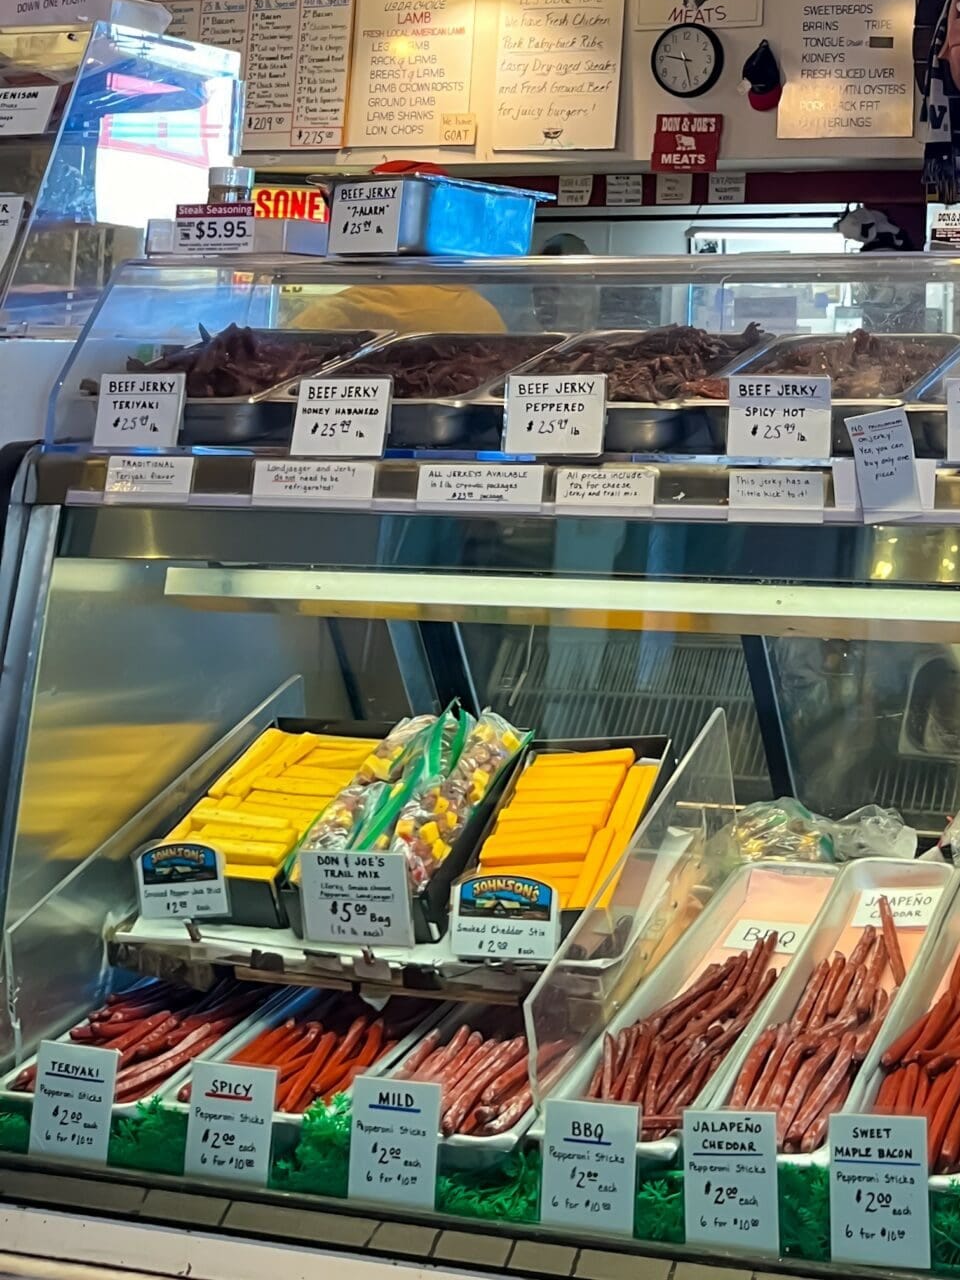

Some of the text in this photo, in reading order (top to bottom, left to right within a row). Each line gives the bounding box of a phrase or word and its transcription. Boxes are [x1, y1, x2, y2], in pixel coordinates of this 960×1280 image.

[17, 0, 40, 13] DOWN
[803, 4, 873, 16] SWEETBREADS
[397, 12, 431, 25] LAMB
[803, 21, 839, 31] BRAINS
[803, 37, 844, 47] TONGUE
[802, 53, 845, 63] KIDNEYS
[801, 68, 894, 79] FRESH SLICED LIVER
[368, 97, 436, 107] GROUND LAMB
[367, 111, 434, 121] LAMB SHANKS
[661, 117, 715, 132] DON & JOE'S
[444, 130, 469, 141] GOAT
[661, 154, 706, 165] MEATS
[341, 186, 397, 200] BEEF JERKY
[179, 204, 253, 217] Steak Seasoning
[195, 221, 247, 240] $5.95
[109, 380, 175, 393] BEEF JERKY
[518, 382, 595, 395] BEEF JERKY
[738, 384, 817, 397] BEEF JERKY
[113, 400, 159, 410] TERIYAKI
[525, 402, 585, 413] PEPPERED
[745, 407, 806, 418] SPICY HOT
[324, 870, 380, 879] TRAIL MIX
[473, 880, 539, 903] JOHNSON'S
[51, 1061, 100, 1078] TERIYAKI
[211, 1079, 253, 1097] SPICY
[378, 1091, 415, 1108] MILD
[571, 1121, 604, 1138] BBQ
[692, 1117, 762, 1135] JALAPEÑO
[852, 1127, 892, 1140] SWEET
[702, 1140, 757, 1152] CHEDDAR
[835, 1147, 913, 1160] MAPLE BACON
